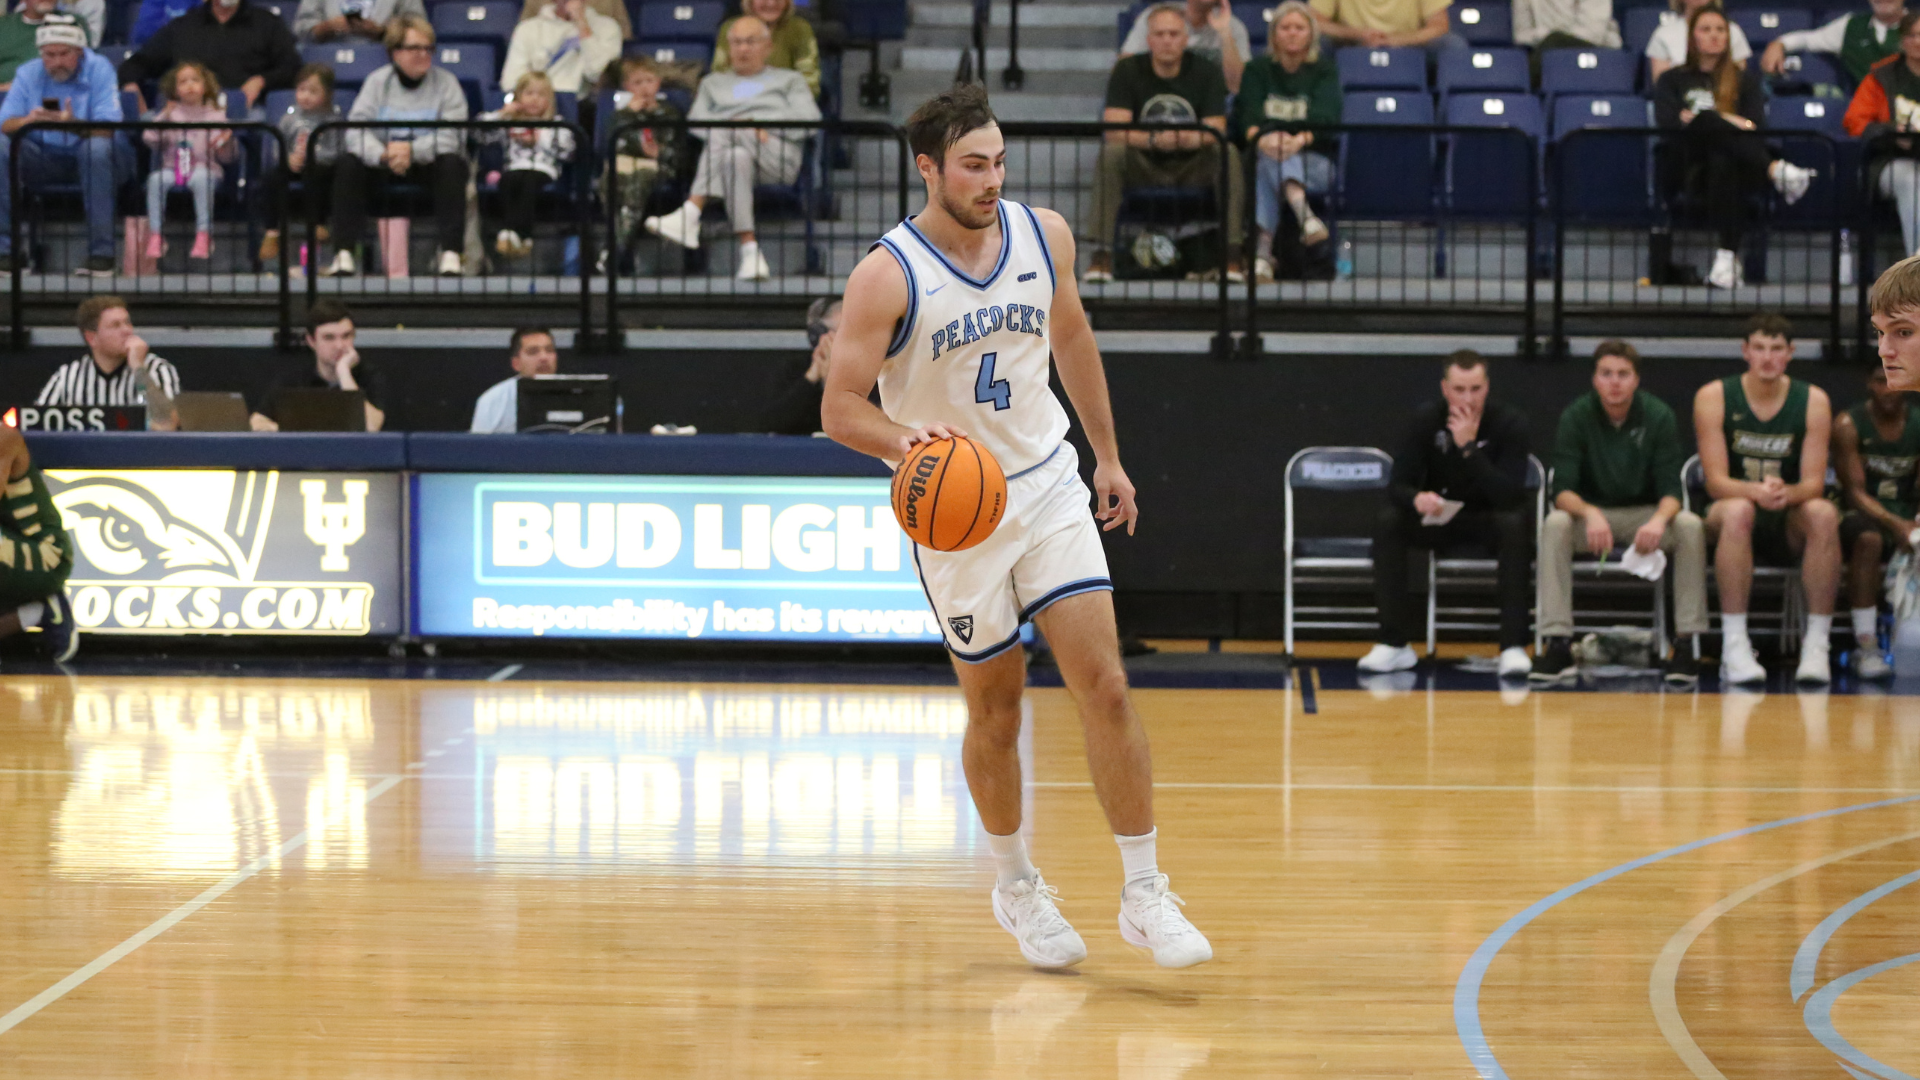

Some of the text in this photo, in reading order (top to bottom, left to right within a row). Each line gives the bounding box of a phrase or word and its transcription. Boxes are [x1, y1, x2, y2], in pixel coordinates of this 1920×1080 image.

[931, 303, 1045, 361] PEACOCKS
[974, 351, 1012, 412] 4
[20, 408, 106, 432] POSS
[906, 455, 941, 529] Wilson
[492, 501, 902, 573] BUD LIGH
[65, 586, 369, 629] OCKS.COM
[472, 597, 709, 638] Responsibility
[712, 600, 775, 631] has
[779, 601, 823, 633] its
